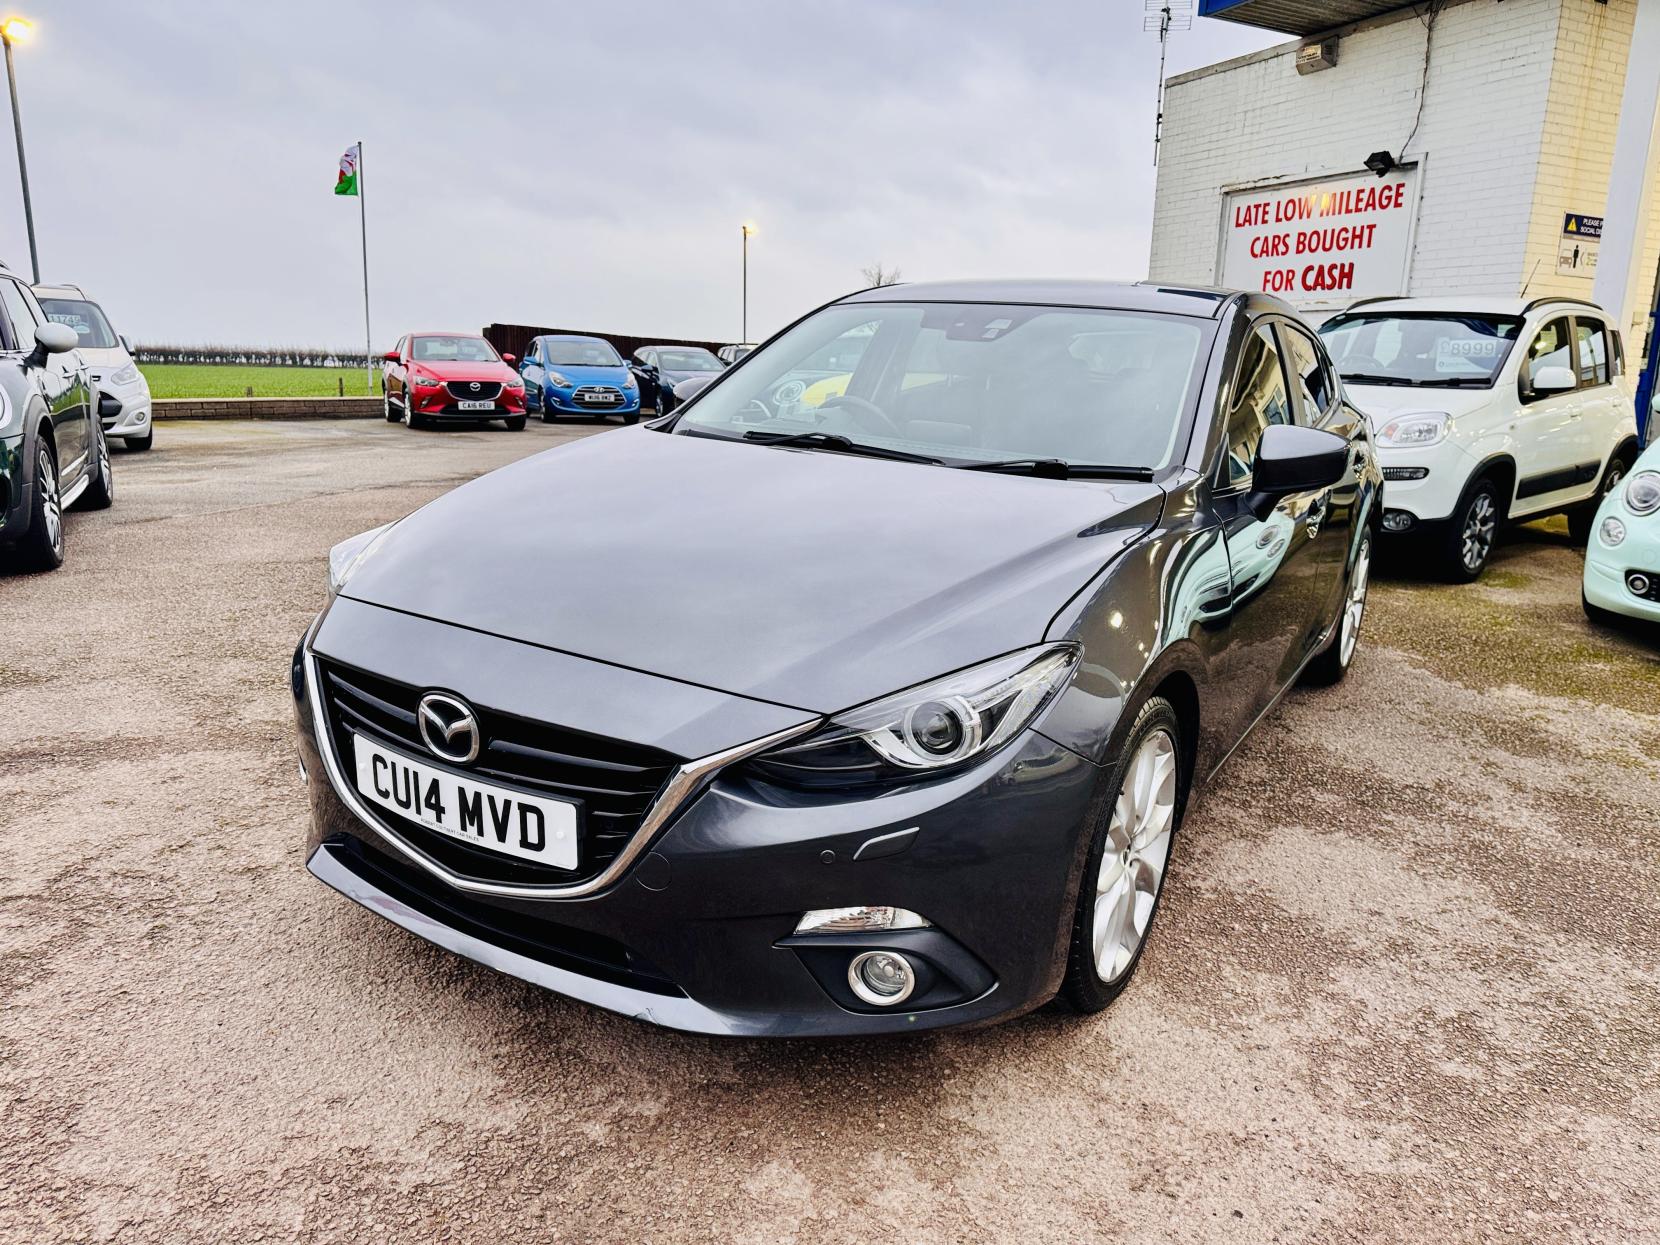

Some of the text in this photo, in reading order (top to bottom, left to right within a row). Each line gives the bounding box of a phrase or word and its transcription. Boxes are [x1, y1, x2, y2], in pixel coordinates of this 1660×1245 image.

[1235, 183, 1406, 228] LATE LOW MILEAGE
[1580, 226, 1595, 235] SOCIAL
[1583, 218, 1599, 226] PLEASE
[1250, 224, 1377, 259] CARS BOUGHT
[1262, 262, 1355, 292] FOR CASH
[372, 753, 546, 852] CU14 MVD
